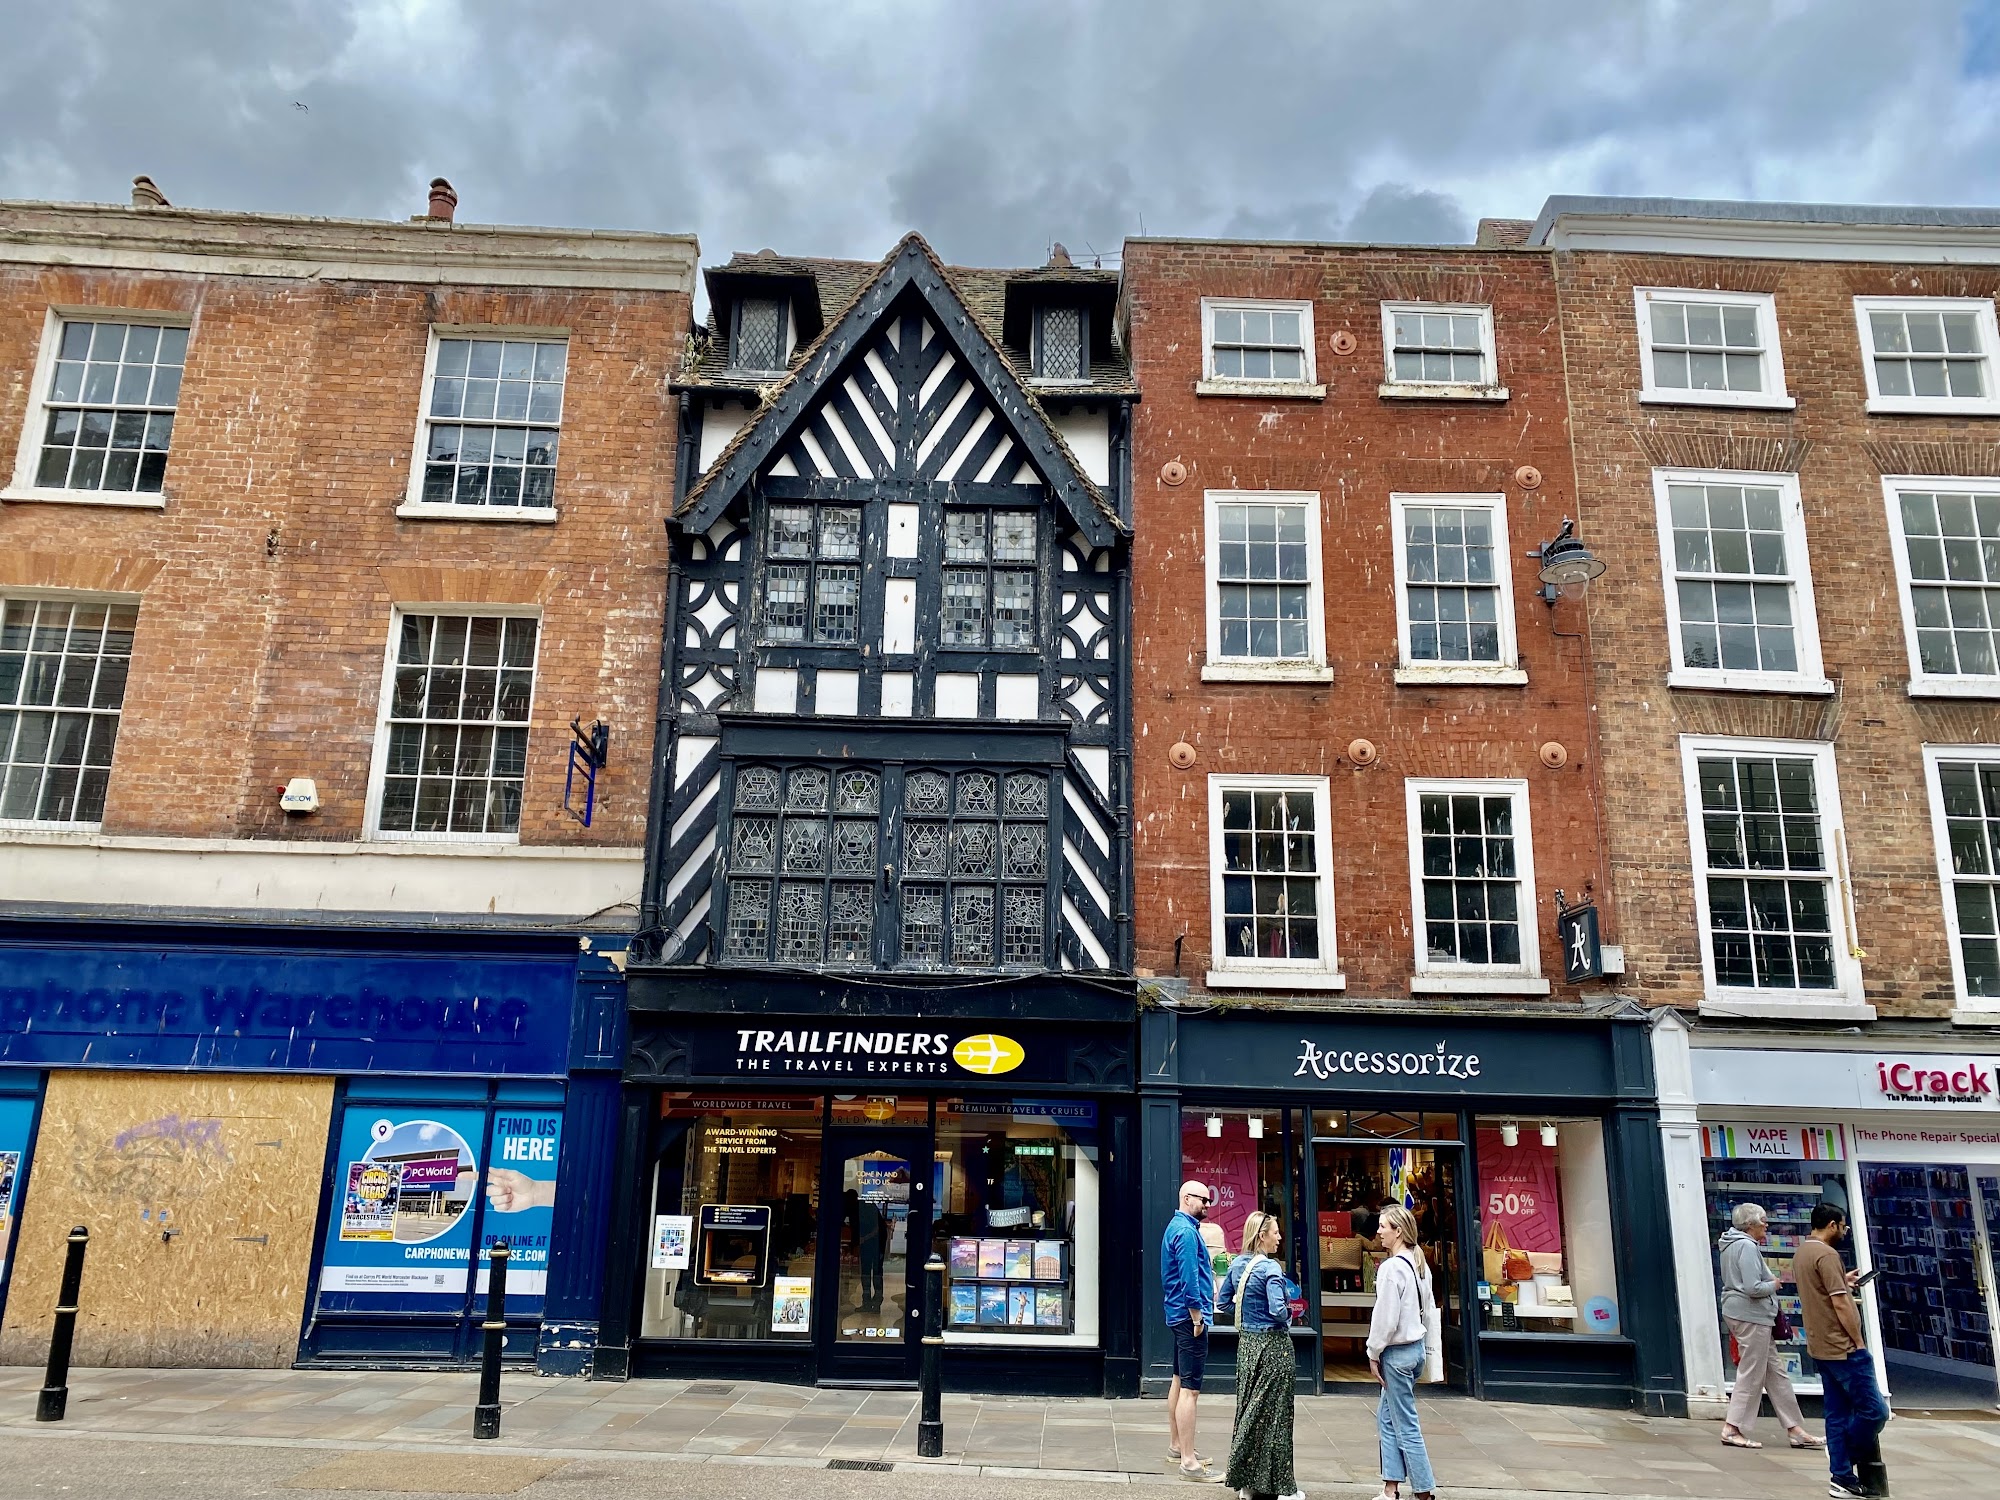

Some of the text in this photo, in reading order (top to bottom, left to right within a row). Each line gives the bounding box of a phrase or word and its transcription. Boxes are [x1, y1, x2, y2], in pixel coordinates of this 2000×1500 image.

[202, 984, 528, 1033] Warehouse
[736, 1030, 949, 1055] TRAILFINDERS
[736, 1059, 949, 1073] THE TRAVEL EXPERTS
[1293, 1039, 1481, 1080] Accessorize
[1878, 1062, 1992, 1094] iCrack
[1886, 1093, 1900, 1102] The
[1901, 1094, 1923, 1102] Phone
[692, 1100, 791, 1110] WORLDWIDE TRAVEL
[954, 1104, 1085, 1116] PREMIUM TRAVEL & CRUISE
[497, 1117, 557, 1136] FIND US
[704, 1128, 778, 1137] AWARD-WINNING
[715, 1137, 744, 1145] SERVICE
[1747, 1128, 1788, 1141] VAPE
[1857, 1130, 1878, 1140] The
[1881, 1131, 1918, 1141] Phone
[1920, 1131, 1957, 1144] Repair
[503, 1136, 555, 1161] HERE
[719, 1146, 745, 1154] TRAVEL
[746, 1146, 777, 1154] EXPERTS
[1750, 1142, 1791, 1155] MALL
[361, 1170, 388, 1185] CIRCUS
[411, 1166, 453, 1178] PC World
[360, 1184, 387, 1200] VEGAS
[1489, 1194, 1535, 1215] 50%
[989, 1208, 1027, 1217] TRAILFINDERS
[535, 1235, 547, 1247] AT
